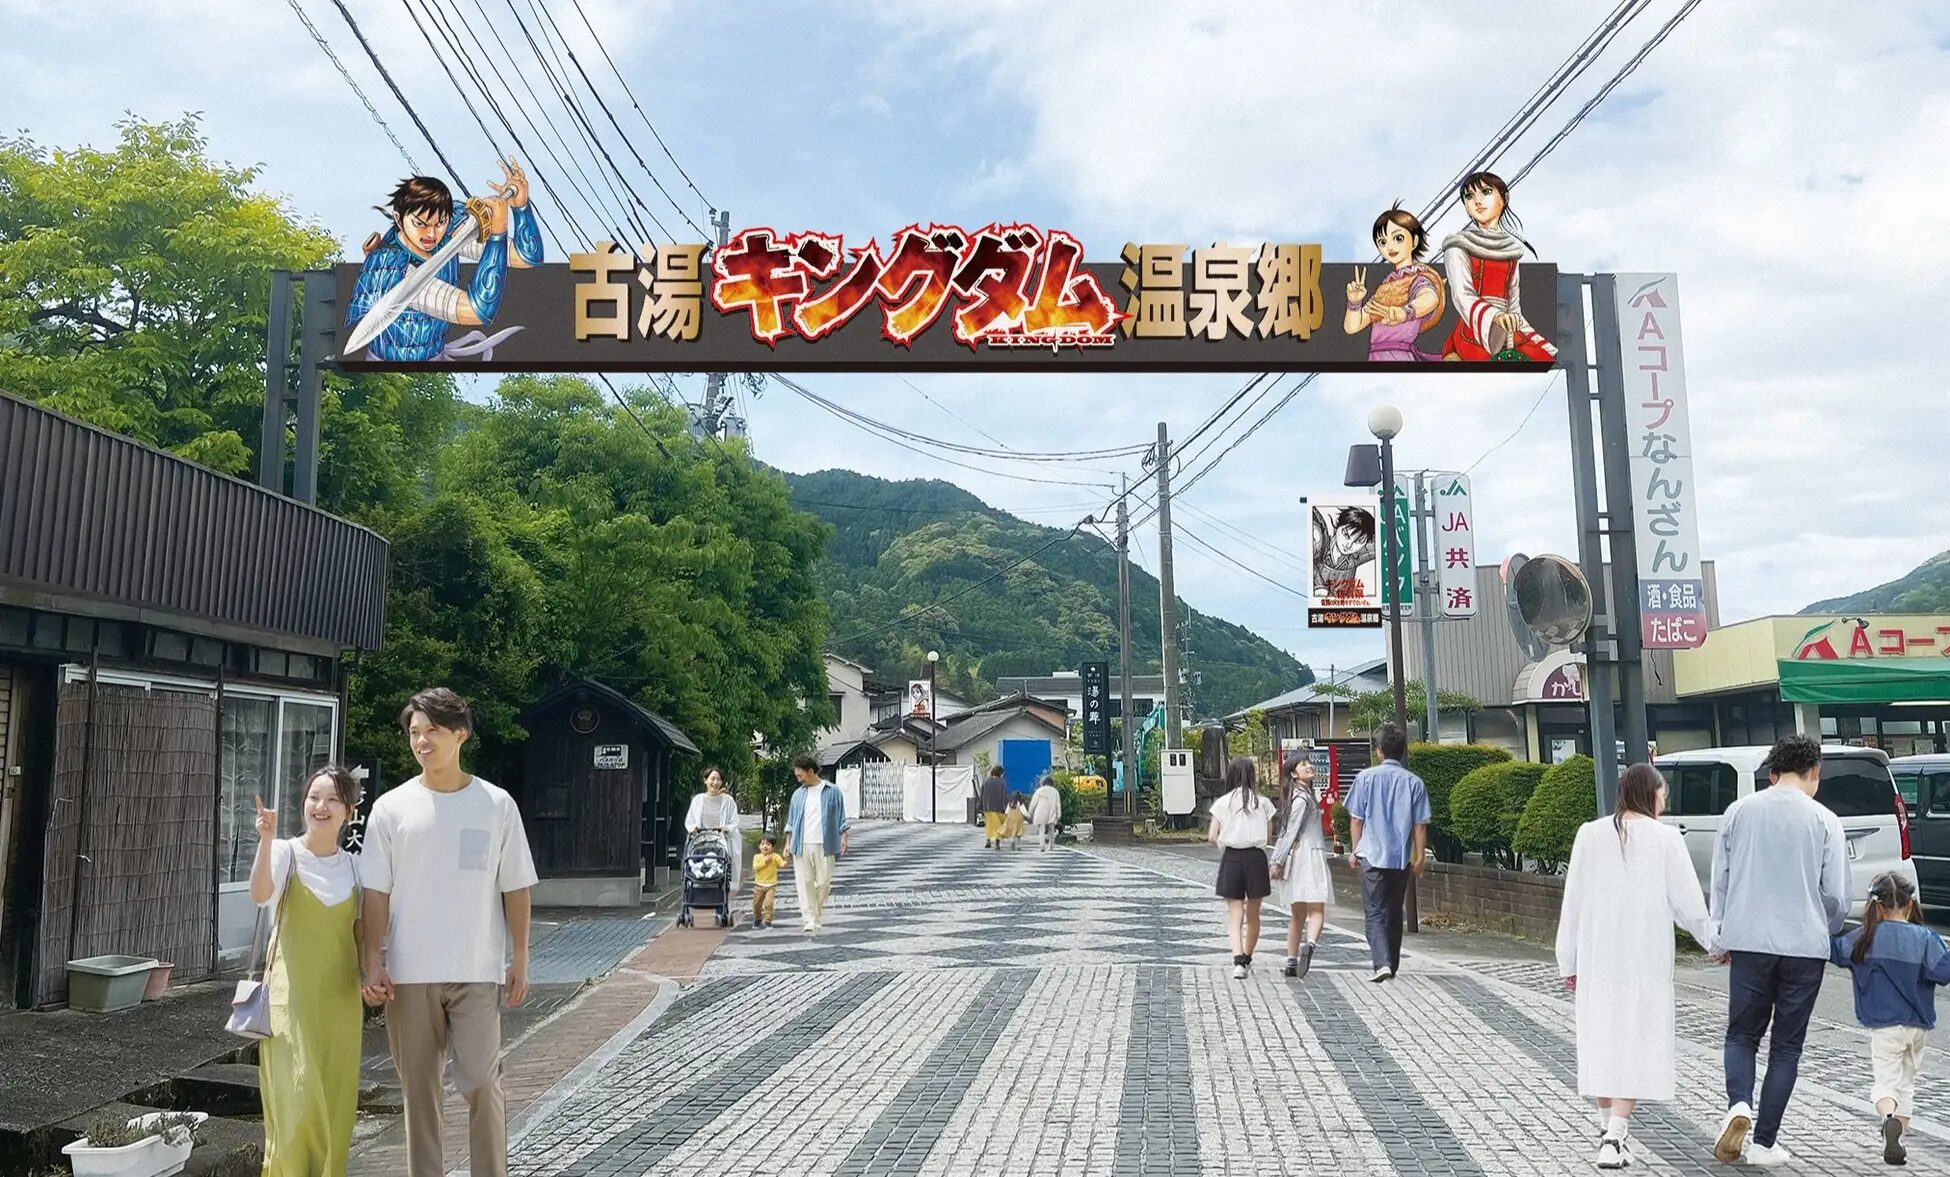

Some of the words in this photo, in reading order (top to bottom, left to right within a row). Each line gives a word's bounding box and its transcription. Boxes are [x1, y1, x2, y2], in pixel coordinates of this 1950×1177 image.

[569, 224, 1324, 349] 古湯キングダム温泉郷
[989, 333, 1114, 347] KINGDOM
[1636, 311, 1688, 573] Aコープなんざん
[1441, 511, 1472, 609] JA共済
[1646, 583, 1697, 609] 酒・食品
[1650, 616, 1698, 643] たばこ
